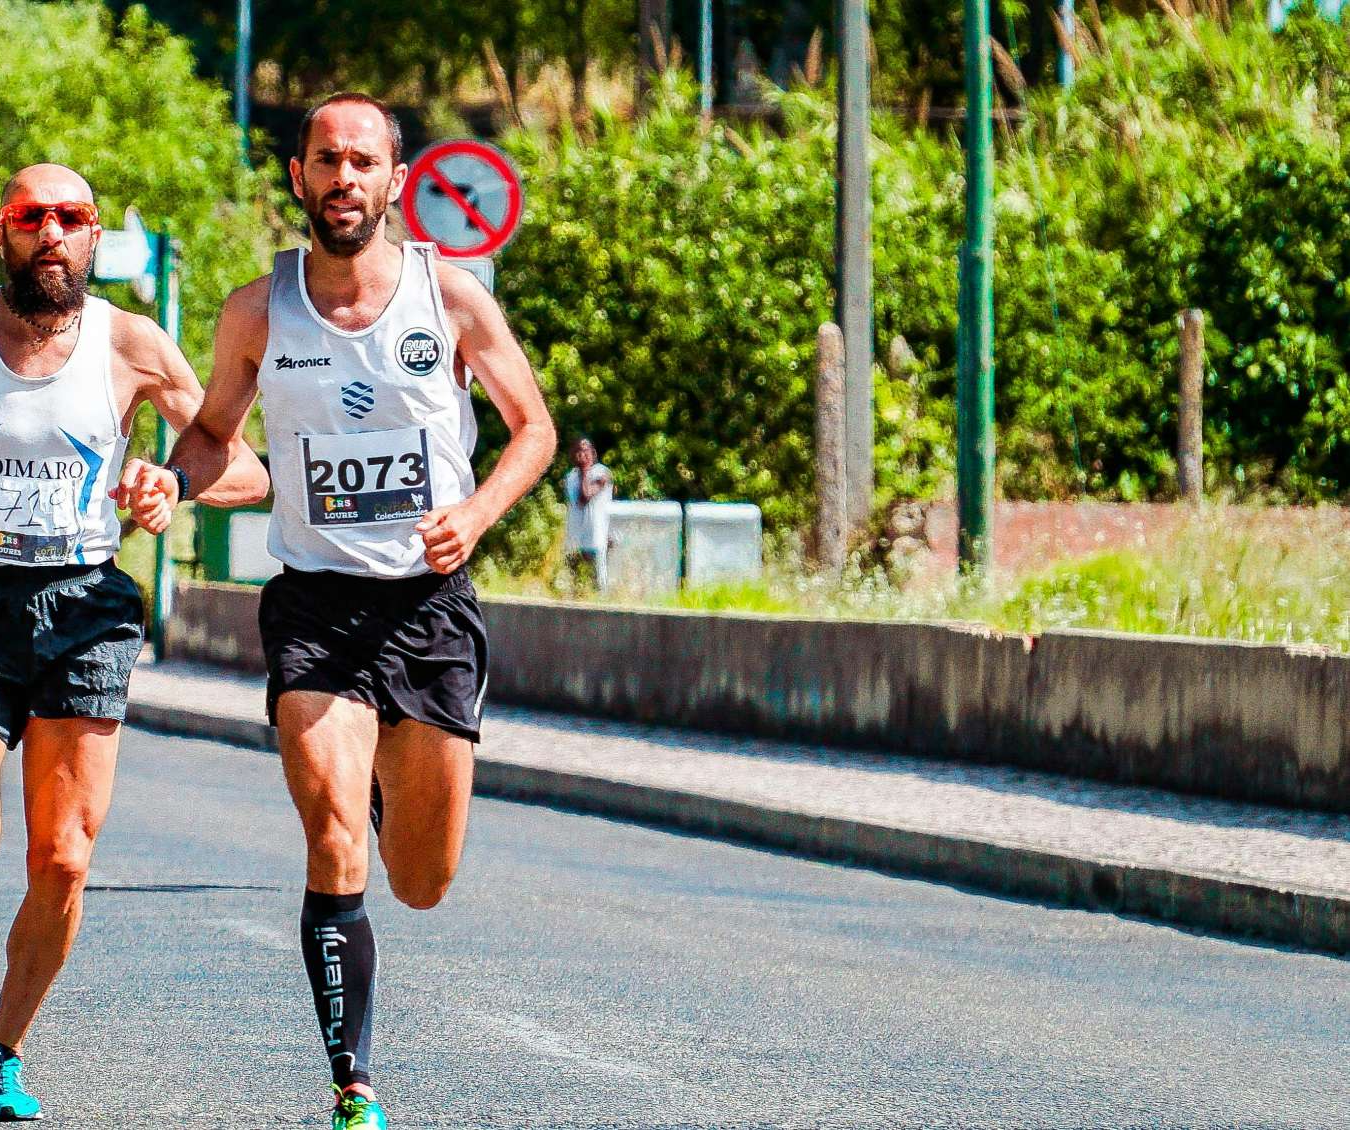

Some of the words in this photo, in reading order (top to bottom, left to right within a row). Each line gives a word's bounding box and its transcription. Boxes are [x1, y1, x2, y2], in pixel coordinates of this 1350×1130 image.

[403, 339, 435, 351] RUN
[402, 350, 437, 362] TEJO
[309, 452, 427, 494] 2073
[324, 511, 359, 520] LOURES
[314, 926, 347, 1047] kalenji
